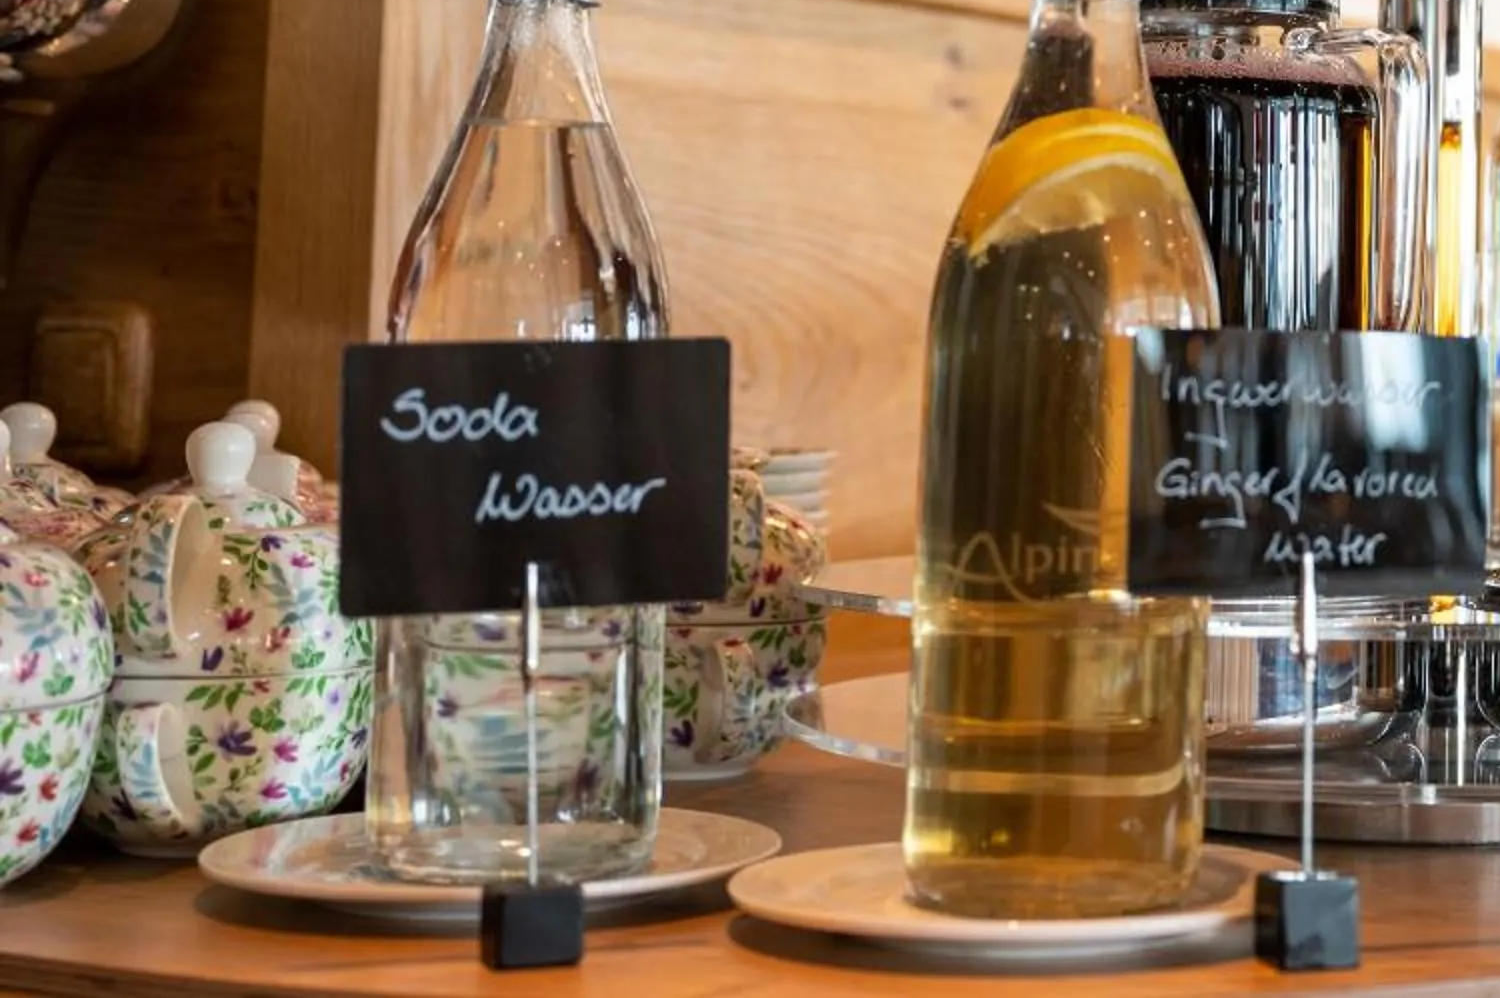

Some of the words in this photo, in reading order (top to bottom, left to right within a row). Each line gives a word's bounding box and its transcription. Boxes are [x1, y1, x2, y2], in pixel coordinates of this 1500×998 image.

[380, 387, 539, 441] Soda
[474, 472, 667, 522] Wasser
[1263, 523, 1389, 567] water
